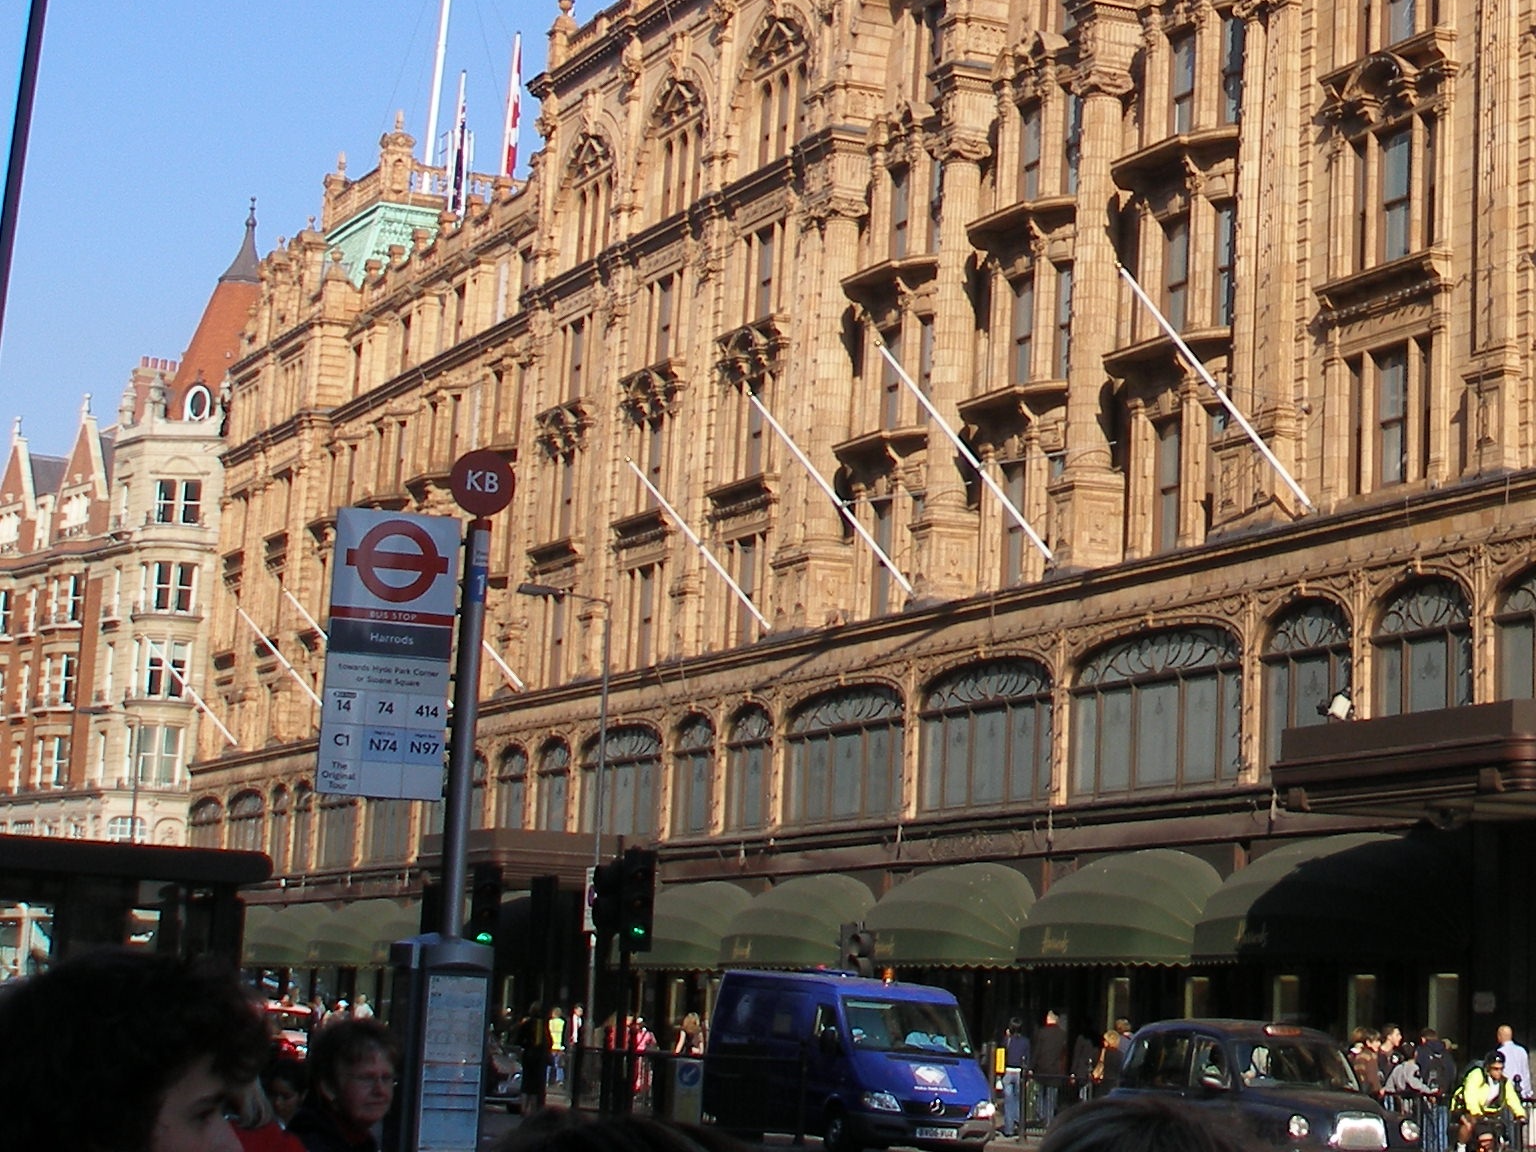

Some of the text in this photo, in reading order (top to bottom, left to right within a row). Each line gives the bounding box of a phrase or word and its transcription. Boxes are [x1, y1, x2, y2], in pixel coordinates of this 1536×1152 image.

[466, 469, 499, 493] KB
[369, 610, 417, 622] BUS STOP
[370, 632, 414, 646] Harrods
[338, 662, 440, 678] towards Hyde Park Corner
[395, 678, 420, 687] Square
[337, 699, 351, 711] 14
[378, 701, 394, 714] 74
[415, 705, 439, 717] 414
[333, 733, 350, 747] C1
[369, 738, 398, 753] N74
[410, 741, 440, 755] N97
[332, 760, 348, 769] The
[321, 770, 356, 781] Original
[329, 781, 348, 790] Tour
